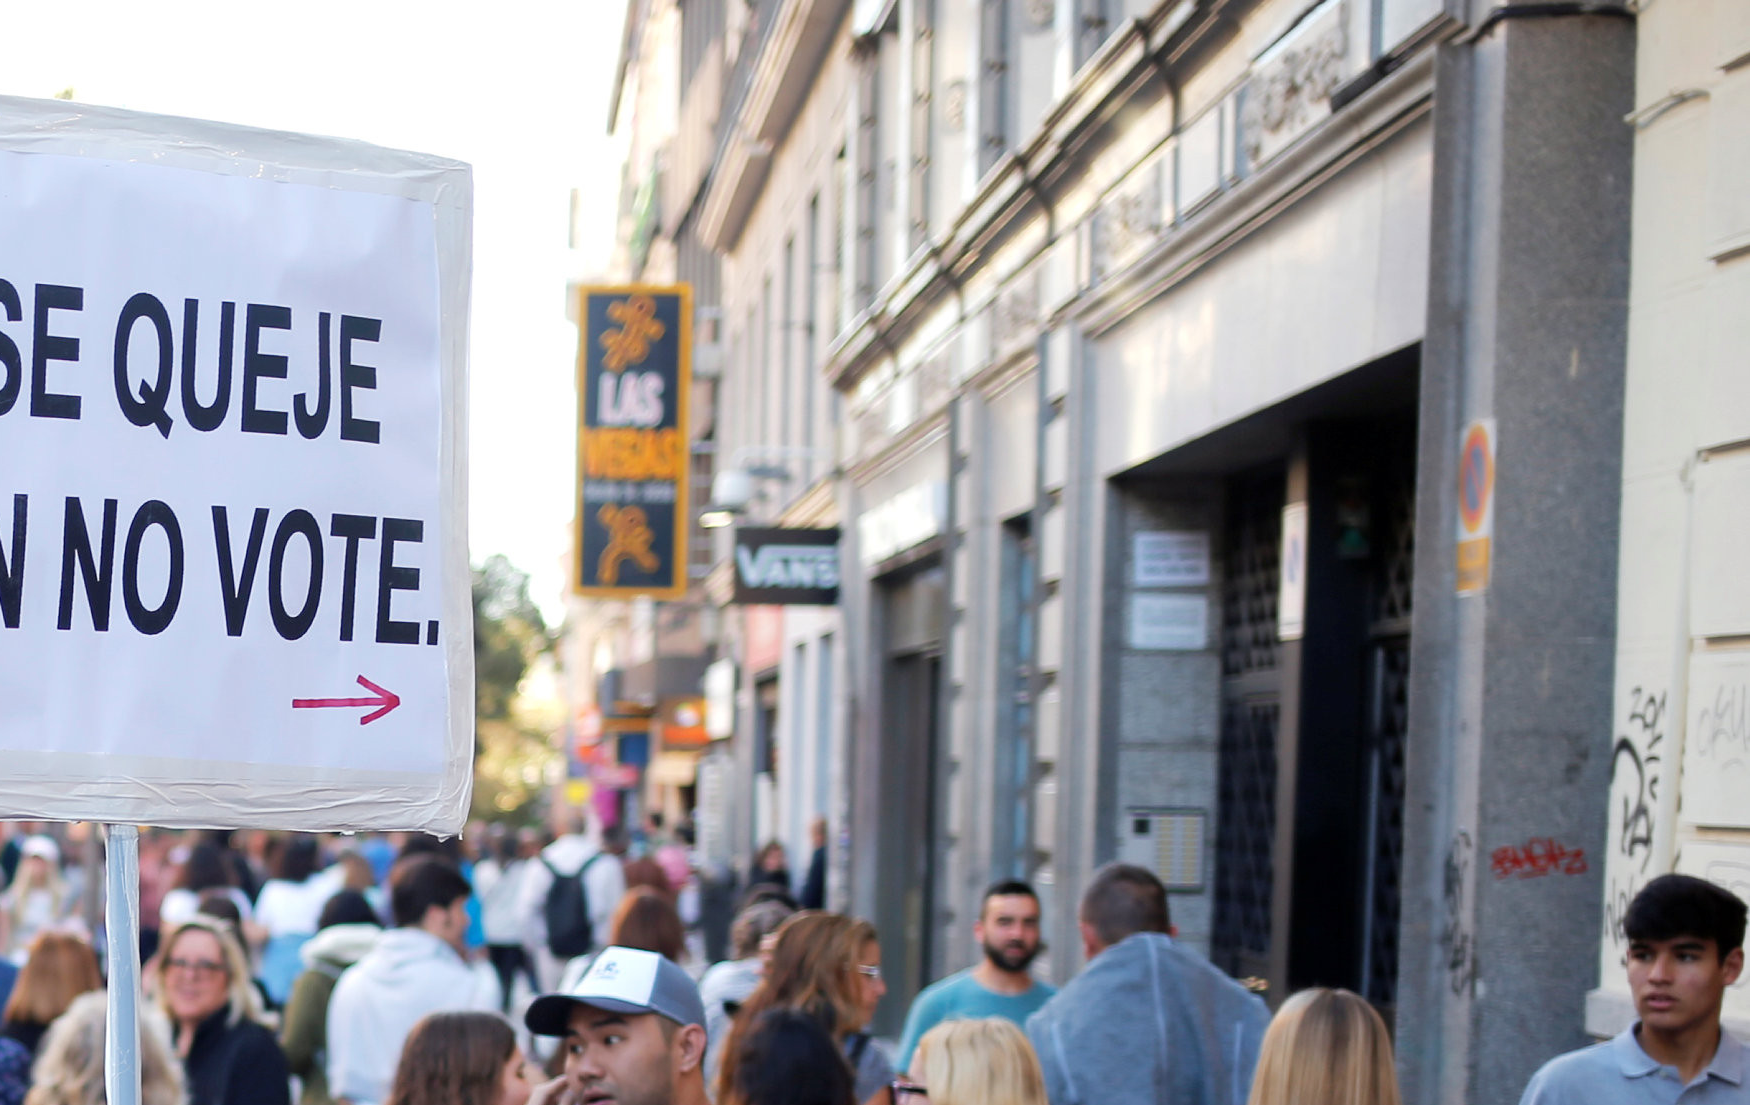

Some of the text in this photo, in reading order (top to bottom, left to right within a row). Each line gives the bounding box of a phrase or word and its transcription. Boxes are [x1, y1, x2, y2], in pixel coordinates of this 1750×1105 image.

[114, 293, 381, 444] QUEJE
[598, 371, 665, 428] LAS
[57, 497, 184, 635] NO
[212, 506, 439, 645] VOTE.
[735, 544, 839, 588] VANS
